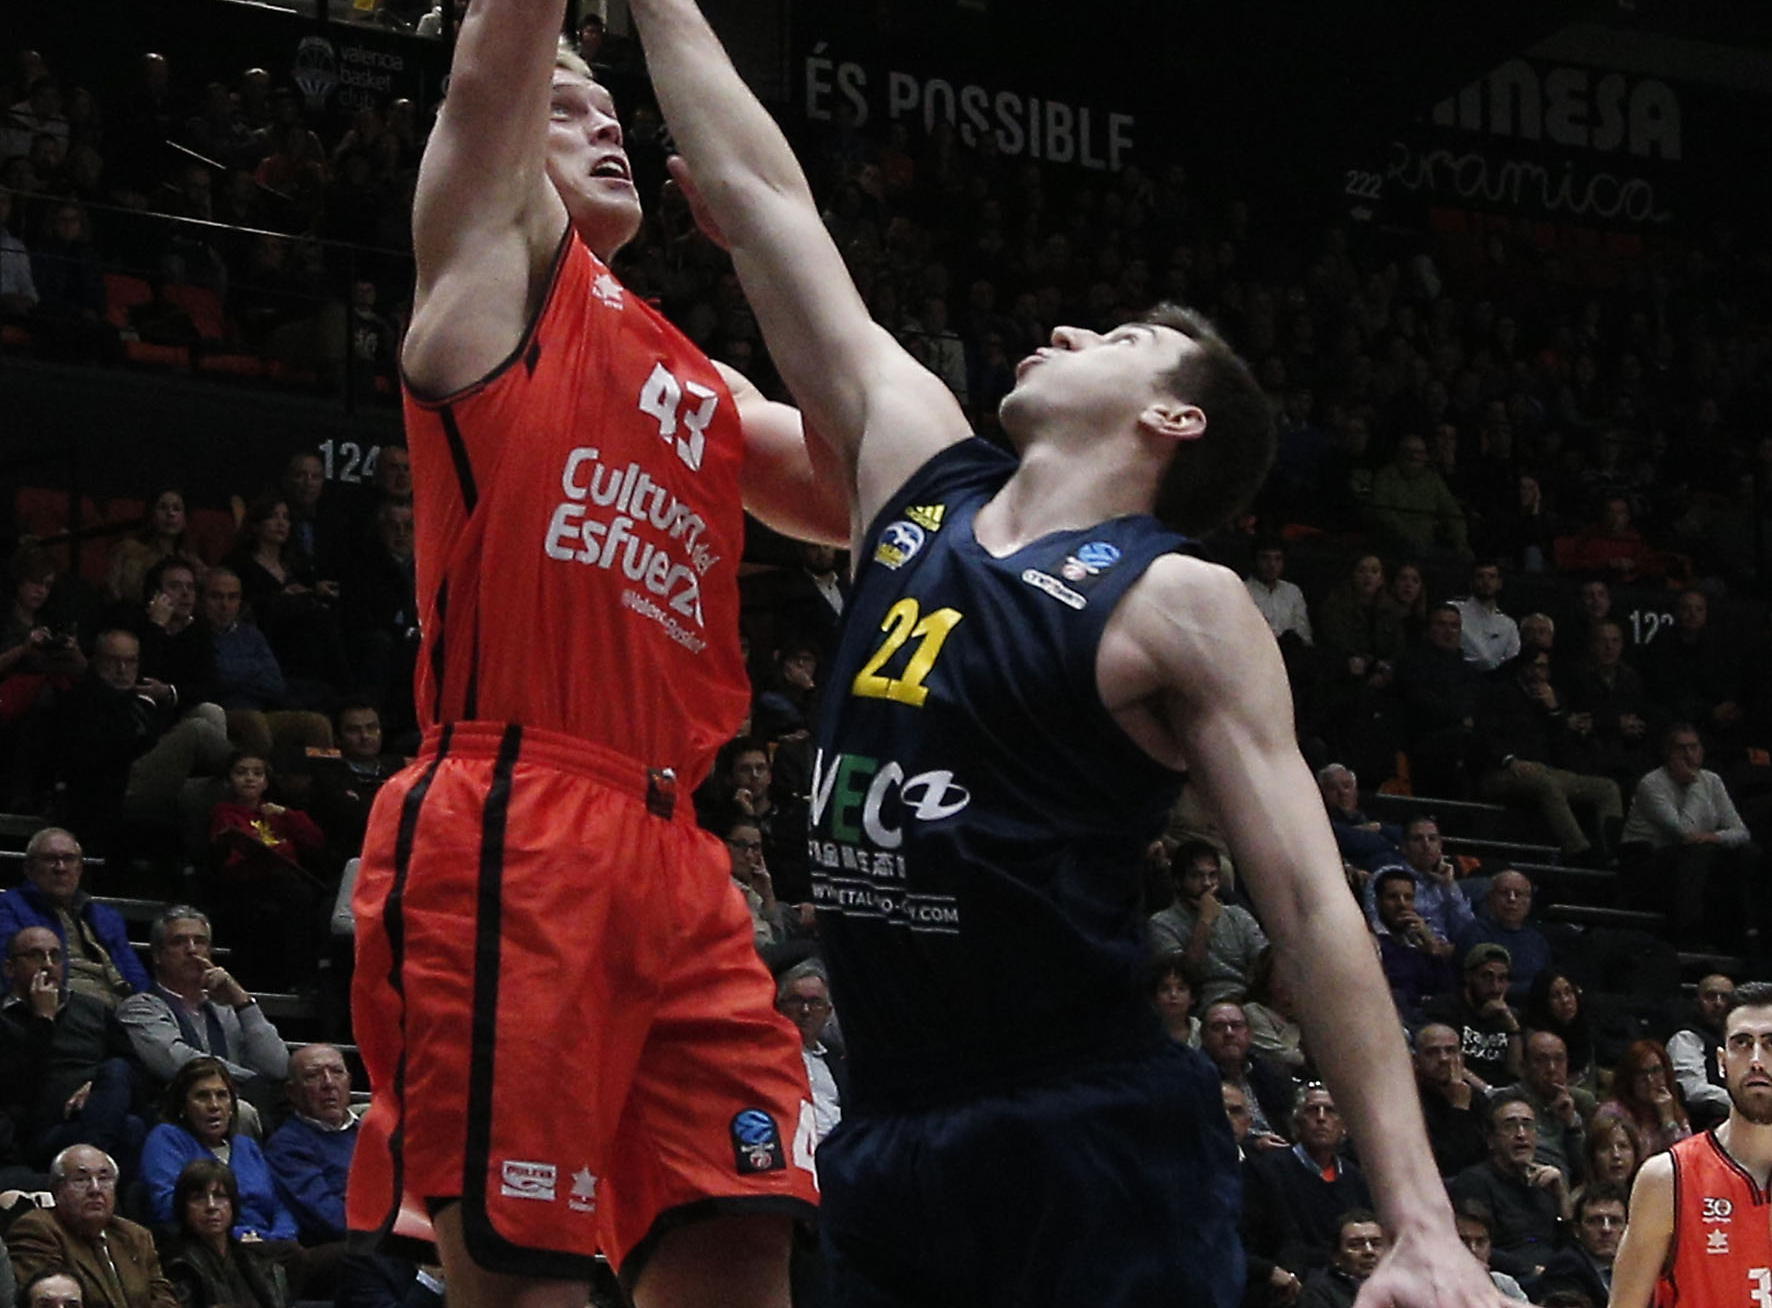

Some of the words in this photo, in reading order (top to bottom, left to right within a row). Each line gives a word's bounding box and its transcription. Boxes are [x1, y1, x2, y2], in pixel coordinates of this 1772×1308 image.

[805, 41, 869, 128] ÉS
[1344, 169, 1382, 199] 222
[638, 360, 720, 473] 43
[318, 439, 381, 485] 124
[852, 596, 965, 708] 21
